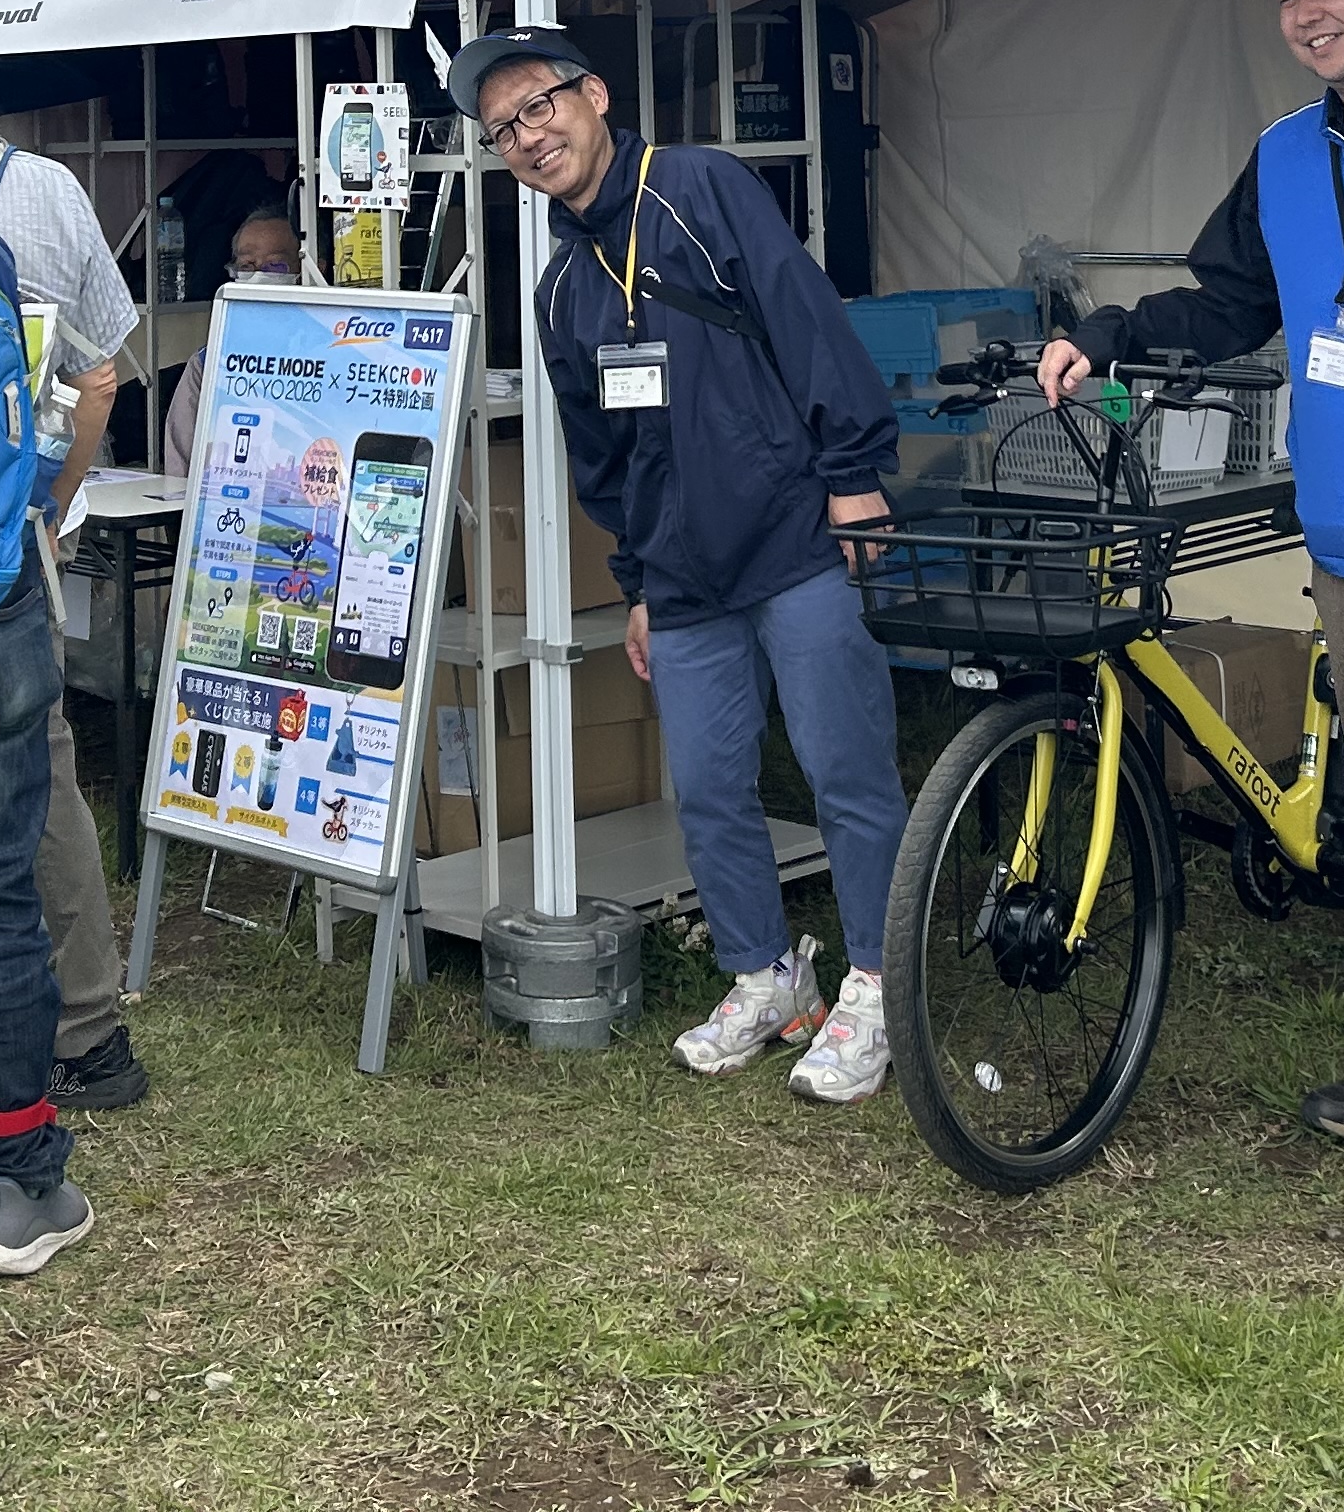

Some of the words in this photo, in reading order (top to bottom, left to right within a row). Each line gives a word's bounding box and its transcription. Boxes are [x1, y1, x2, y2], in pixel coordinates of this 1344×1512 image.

[333, 316, 396, 338] eForce
[411, 327, 444, 345] 7-617
[226, 353, 276, 375] CYCLE
[278, 357, 325, 379] MODE
[345, 386, 435, 411] ブース特別企画
[1110, 397, 1122, 414] 6
[304, 464, 339, 484] 補給食
[204, 701, 273, 730] くじびきを実施
